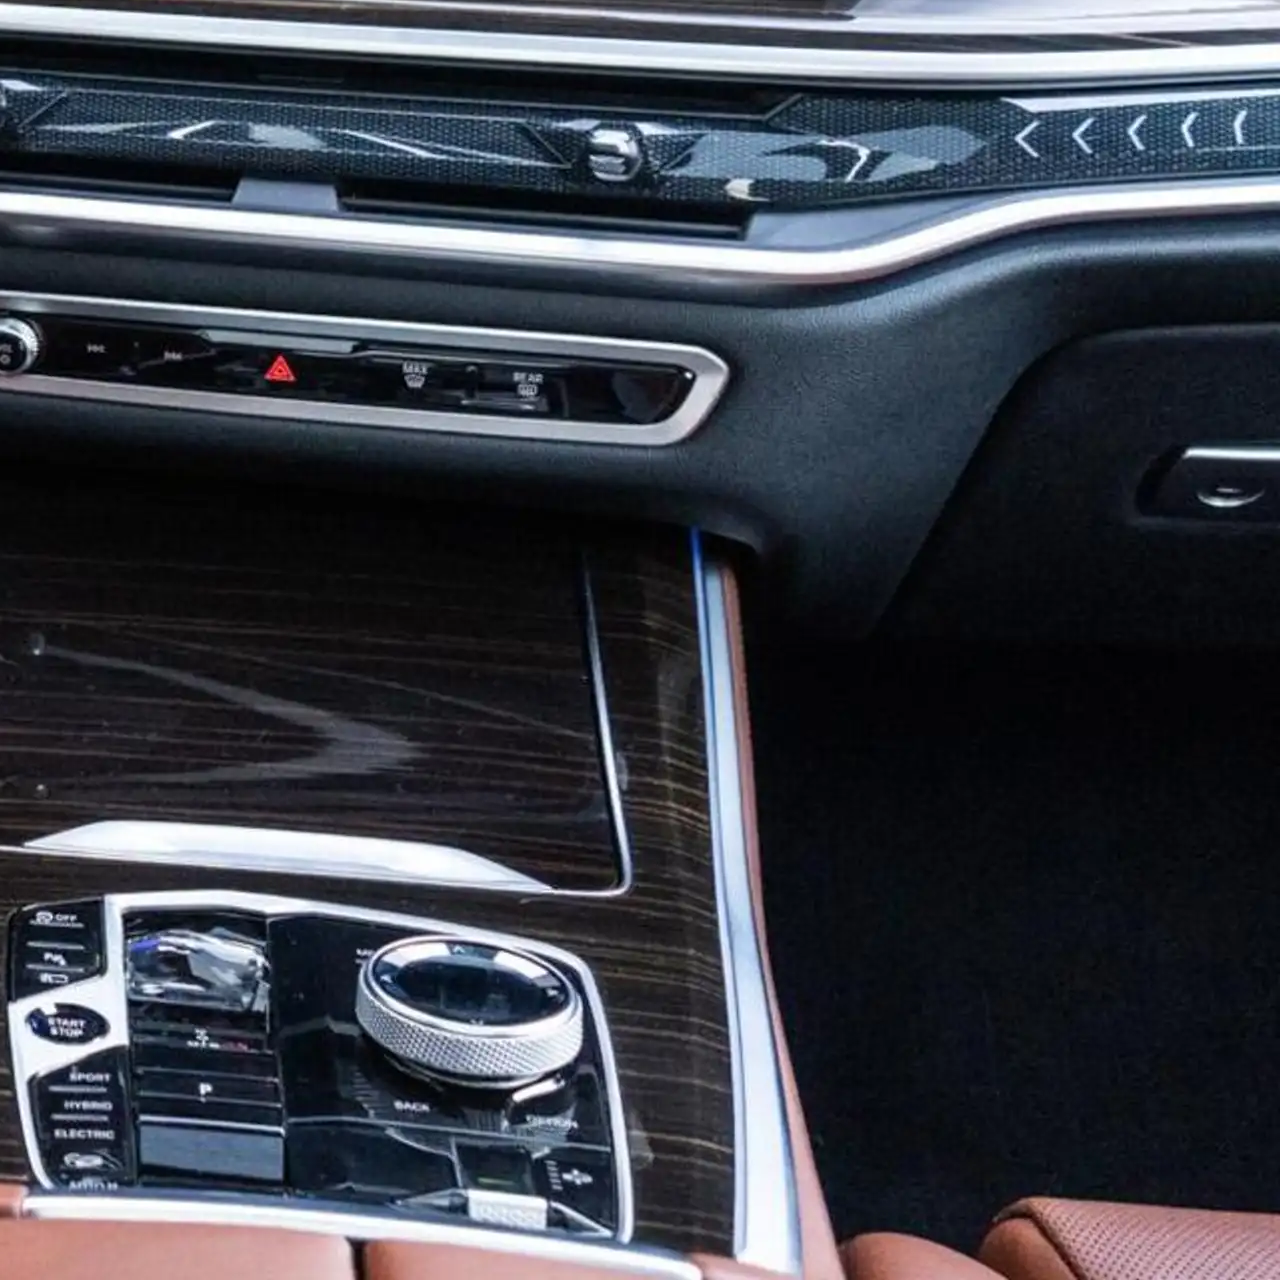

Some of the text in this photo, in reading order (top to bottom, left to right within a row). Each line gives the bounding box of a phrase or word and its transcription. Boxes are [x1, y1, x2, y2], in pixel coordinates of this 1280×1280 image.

[69, 1072, 110, 1082] SPORT
[63, 1100, 113, 1111] HYBRID
[53, 1128, 116, 1139] ELECTRIC
